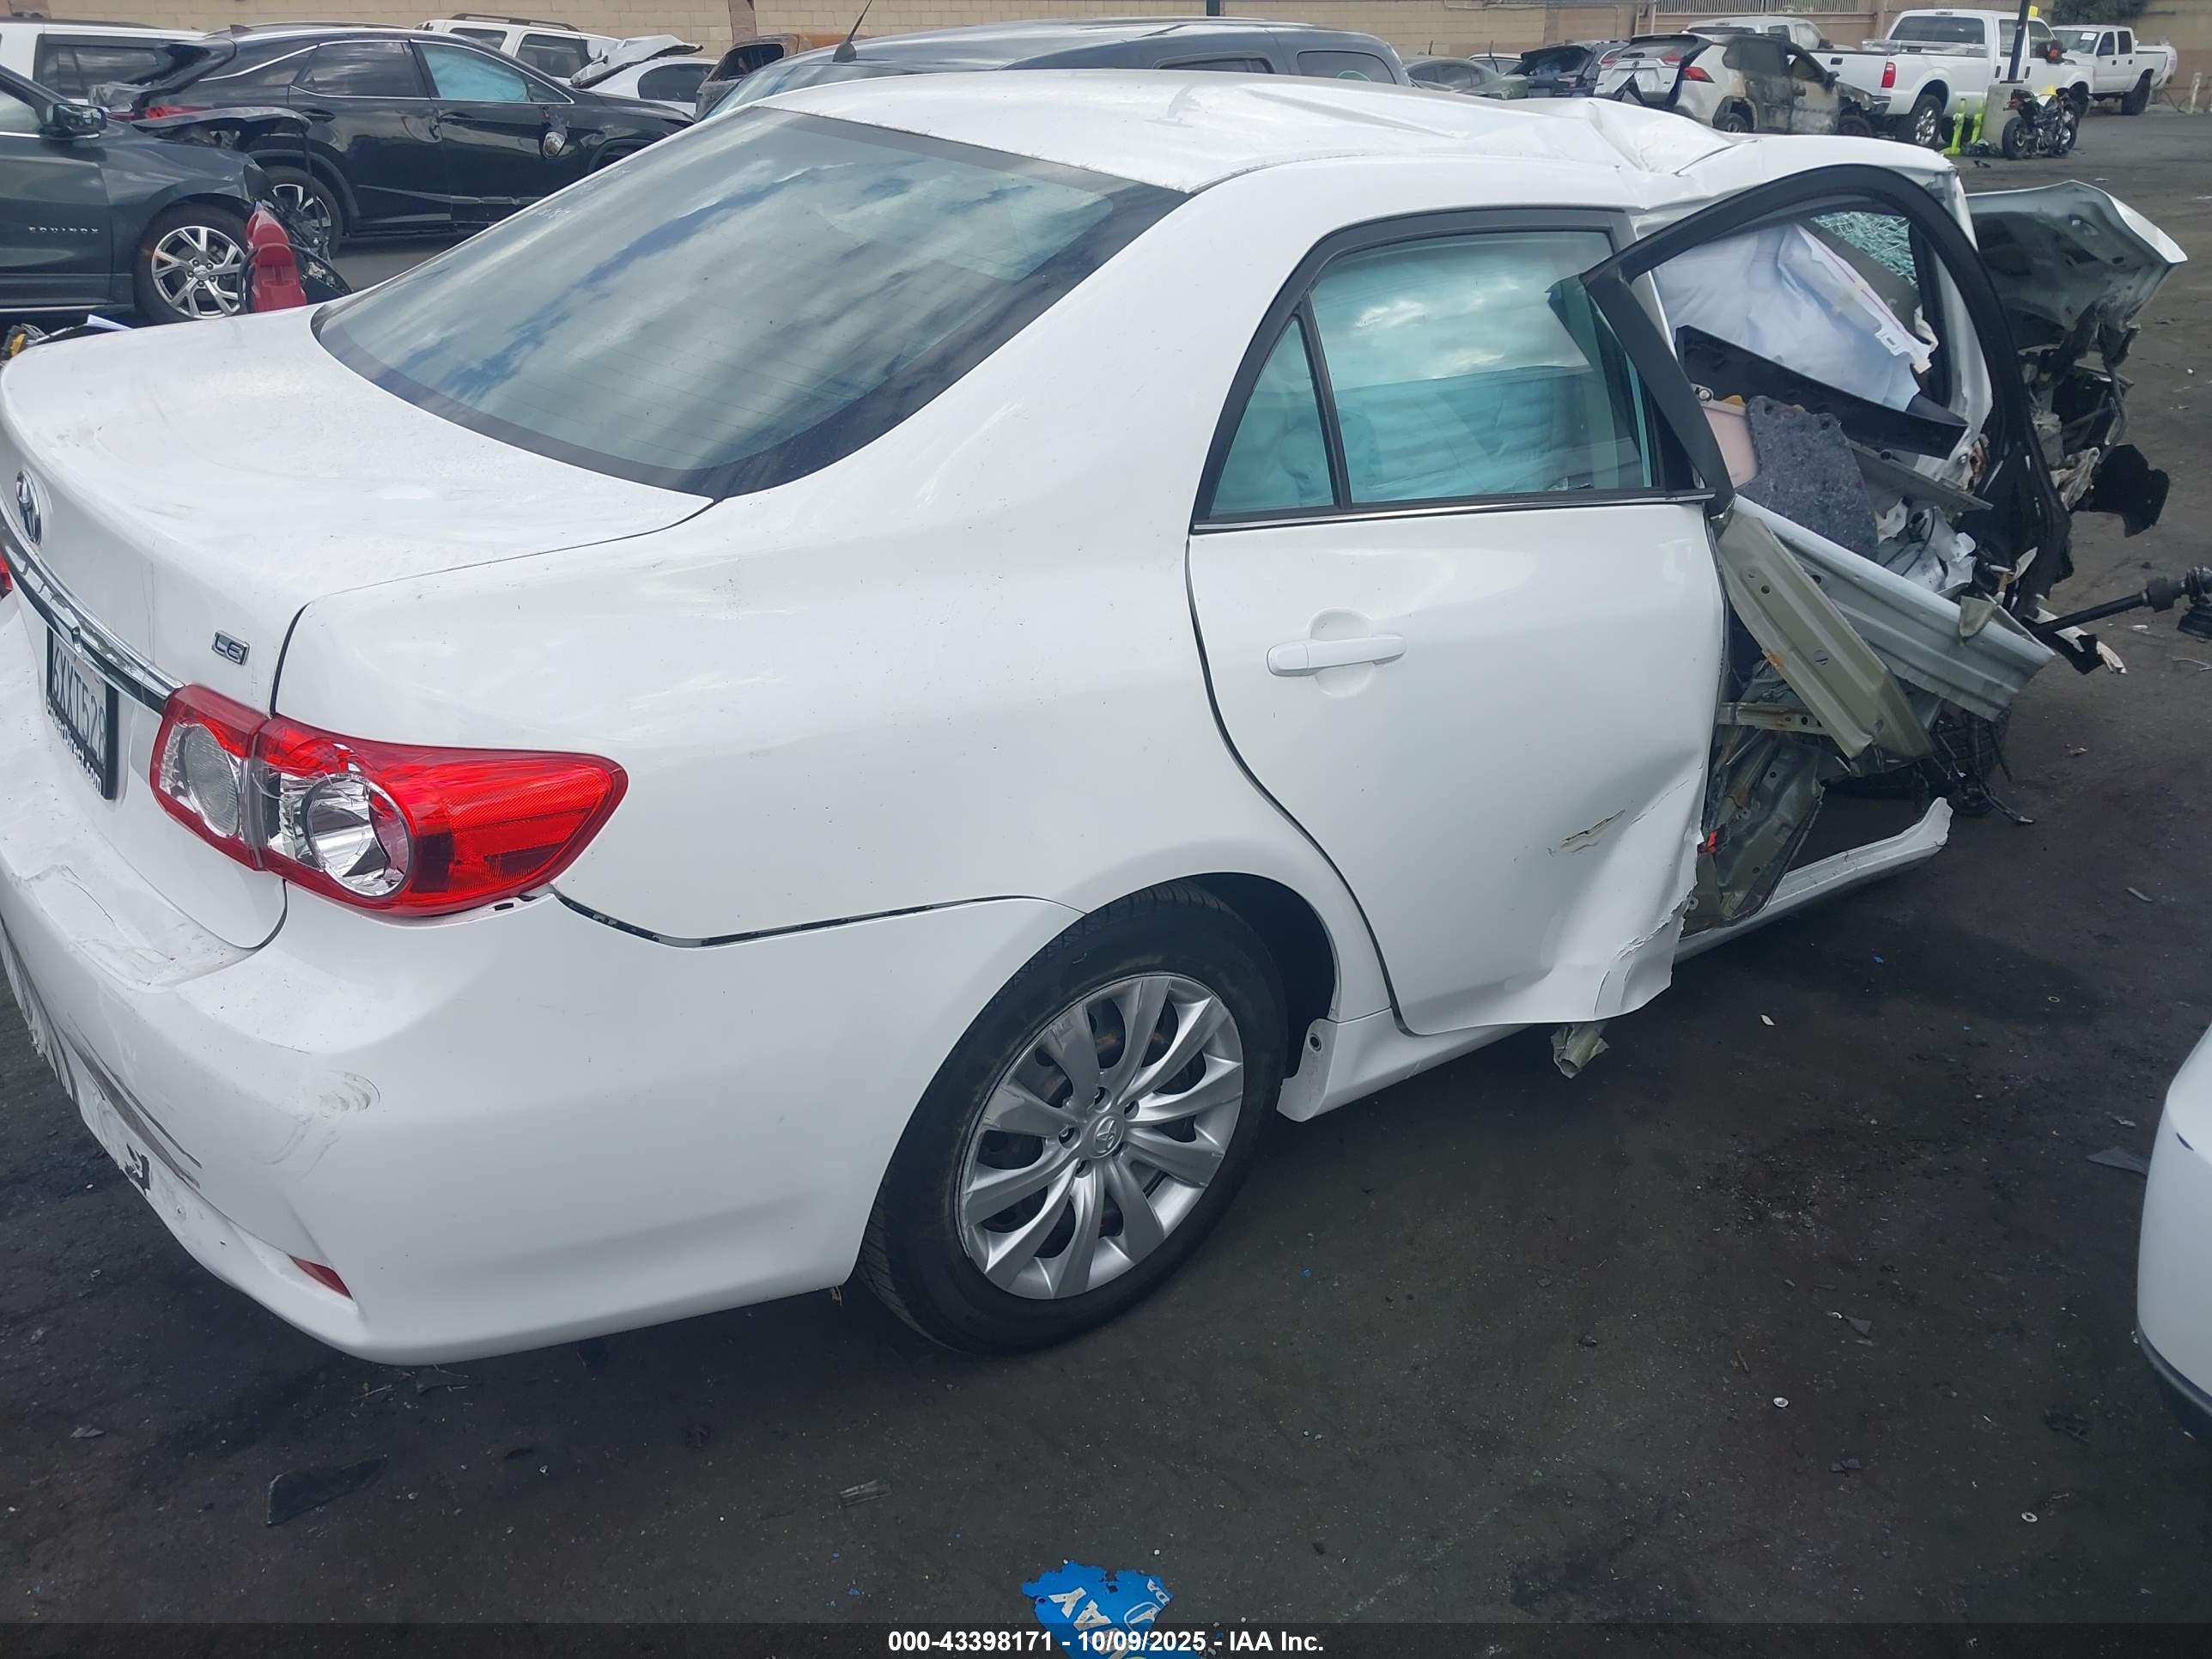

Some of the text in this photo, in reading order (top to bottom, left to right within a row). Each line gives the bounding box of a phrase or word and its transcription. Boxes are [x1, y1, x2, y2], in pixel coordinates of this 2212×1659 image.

[28, 226, 99, 234] EQUINOX
[215, 634, 242, 661] LE
[52, 646, 107, 771] 6XXT528
